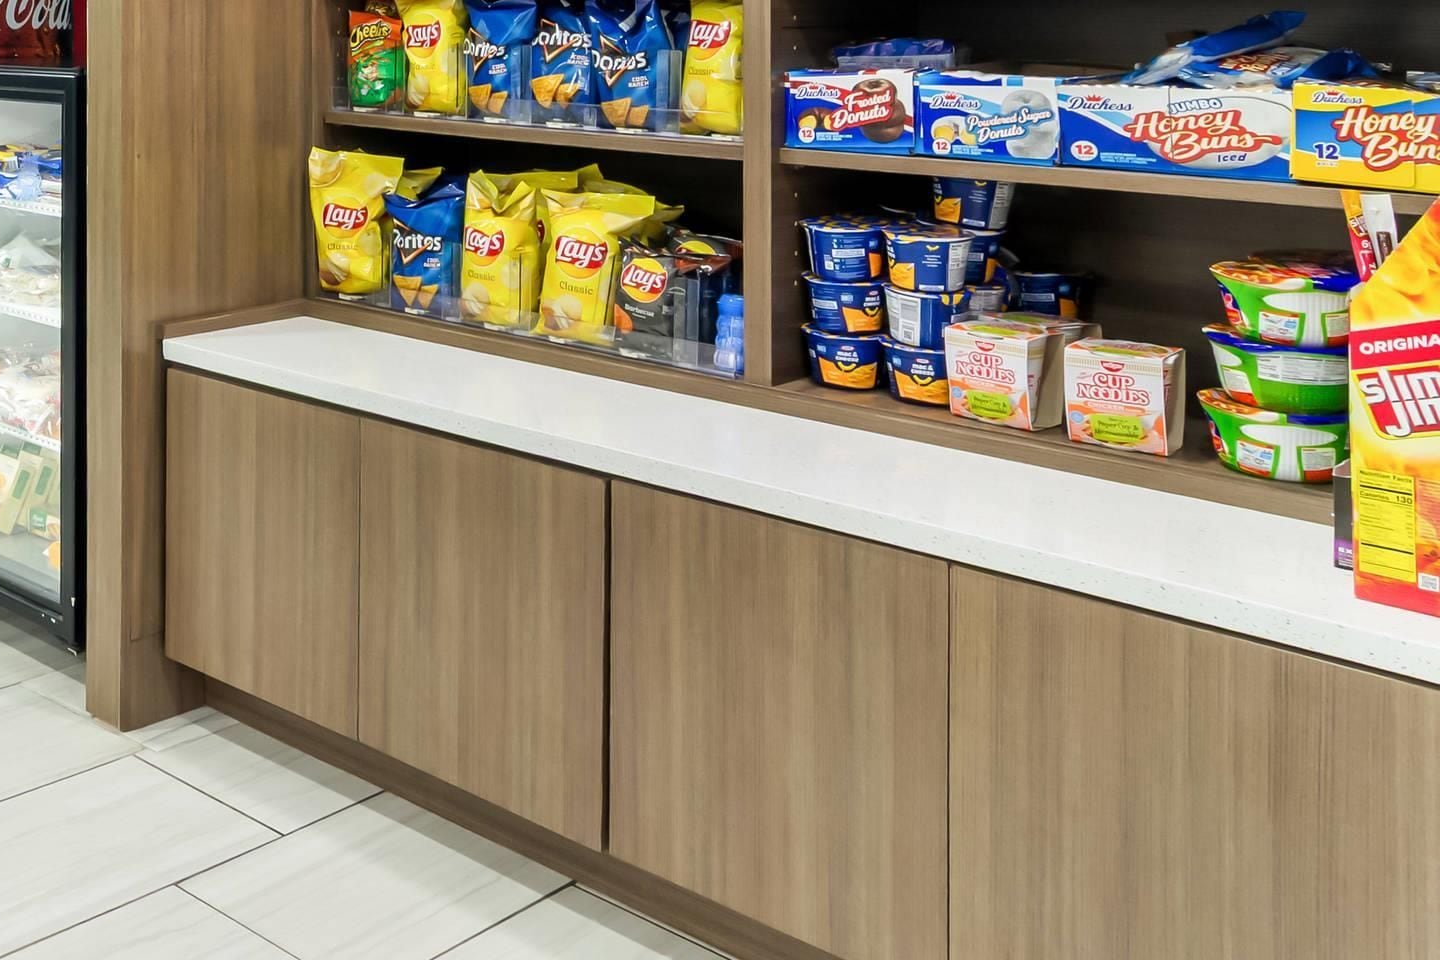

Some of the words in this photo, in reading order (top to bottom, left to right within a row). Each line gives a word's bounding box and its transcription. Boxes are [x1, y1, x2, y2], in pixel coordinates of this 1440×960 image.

[797, 86, 839, 98] Duchess
[844, 89, 891, 112] Frosted
[1311, 90, 1363, 105] Duchess
[929, 95, 980, 110] Duchess
[1067, 96, 1134, 112] Duchess
[1168, 97, 1222, 114] JUMBO
[831, 105, 890, 129] Donuts
[1018, 107, 1051, 124] Sugar
[976, 124, 1025, 143] Donuts
[1127, 112, 1234, 140] Honey
[1334, 107, 1439, 144] Honey
[936, 141, 949, 152] 12
[1074, 143, 1095, 156] 12
[1158, 129, 1282, 160] Buns
[1314, 143, 1339, 161] 12
[1217, 152, 1247, 163] Iced
[556, 235, 607, 269] Lay's
[623, 264, 665, 292] Lay's
[559, 280, 594, 296] Classic
[968, 351, 1003, 368] CUP
[955, 361, 1016, 385] NOODLES
[1092, 372, 1135, 388] CUP
[1076, 382, 1150, 406] NOODLES
[1396, 495, 1413, 505] 130
